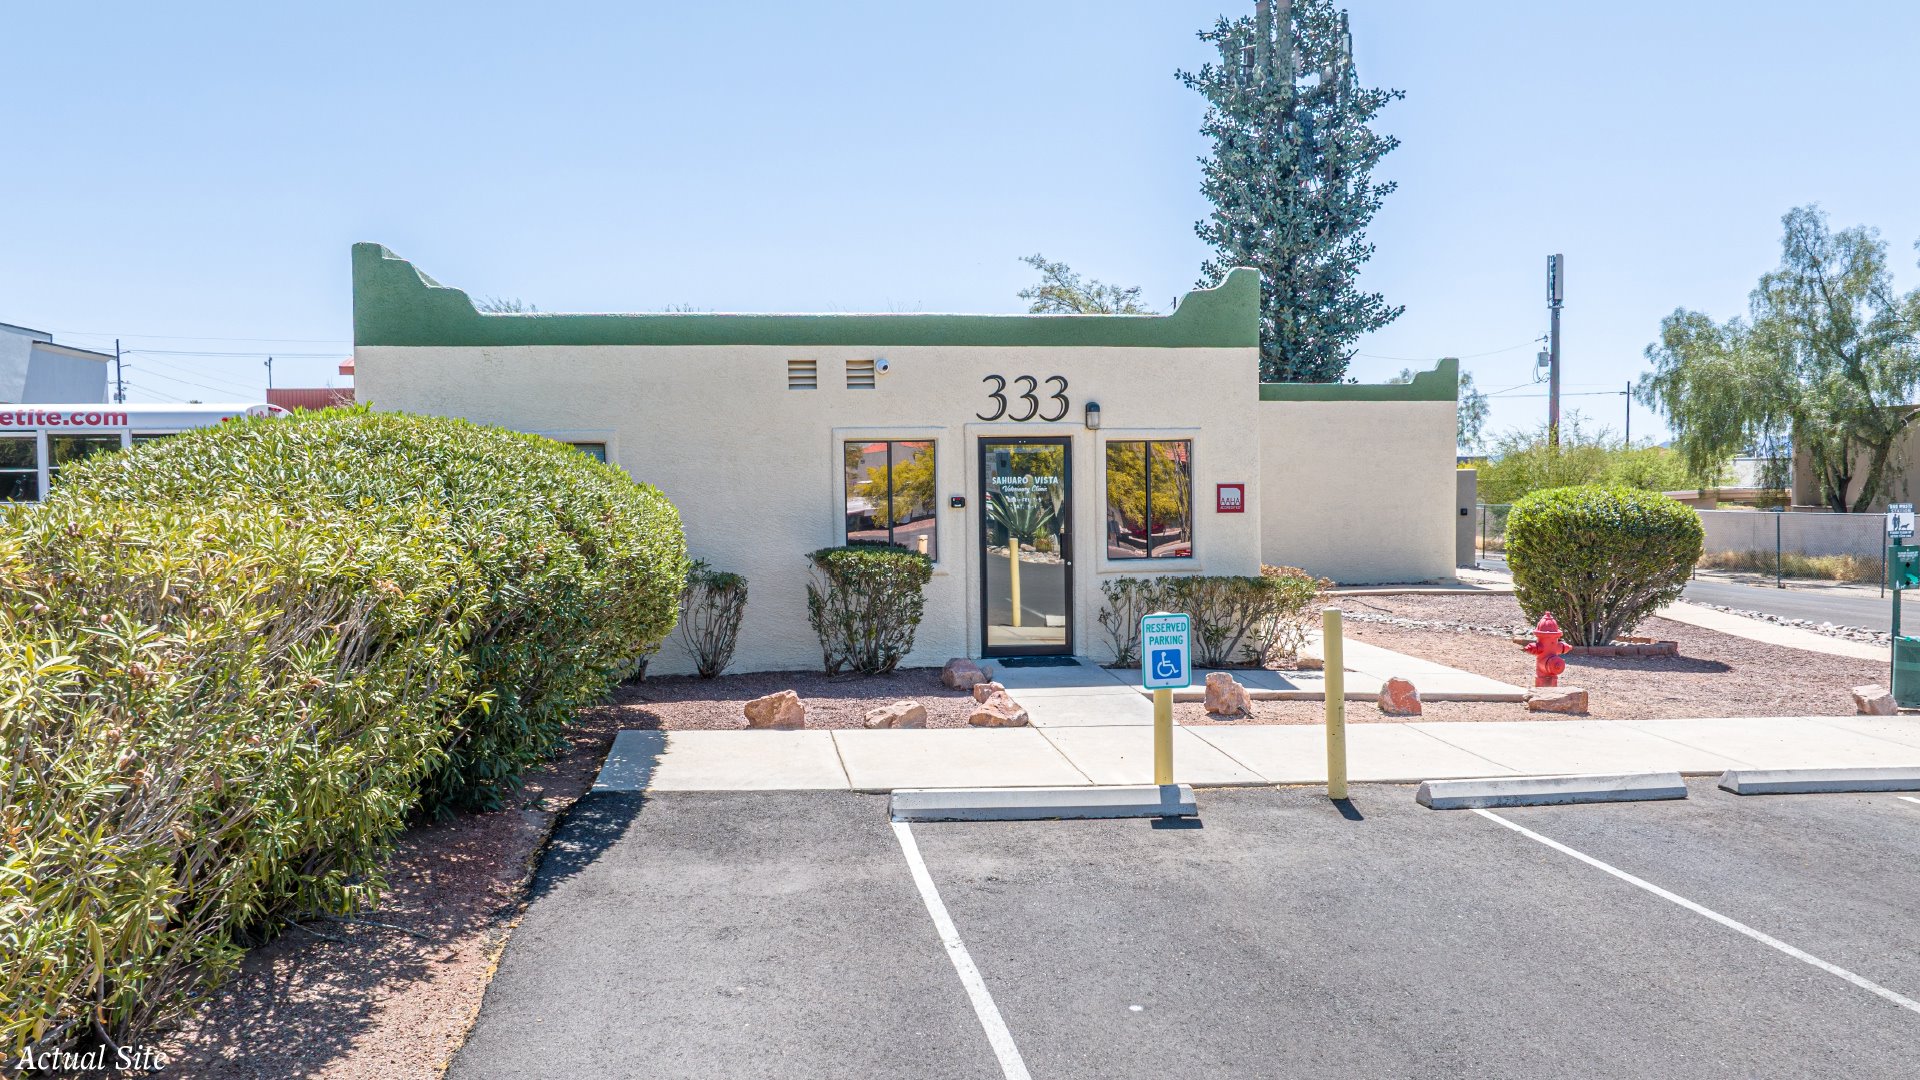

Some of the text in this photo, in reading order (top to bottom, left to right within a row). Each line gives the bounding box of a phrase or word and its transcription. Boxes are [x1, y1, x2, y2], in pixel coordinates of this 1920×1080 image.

[976, 374, 1070, 422] 333
[992, 476, 1059, 485] SAHUARO VISTA
[1220, 497, 1241, 506] AAHA
[1145, 622, 1187, 633] RESERVED
[1149, 635, 1183, 646] PARKING
